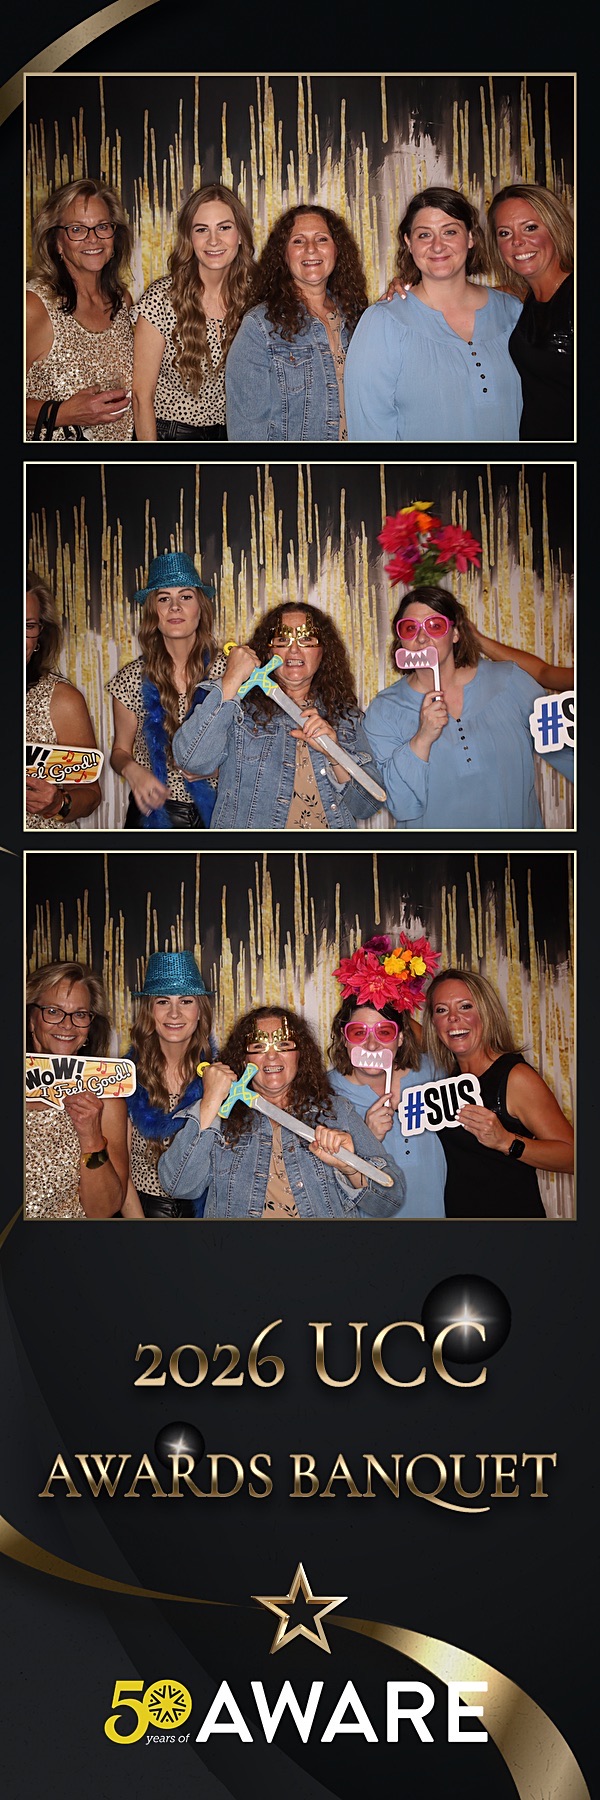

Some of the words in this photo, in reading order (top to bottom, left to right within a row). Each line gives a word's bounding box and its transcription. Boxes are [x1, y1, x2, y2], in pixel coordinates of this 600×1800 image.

[537, 697, 574, 747] #S
[49, 752, 99, 782] Good!
[41, 1086, 50, 1098] I
[54, 1079, 86, 1098] Feel
[87, 1061, 131, 1097] Good!
[404, 1079, 477, 1131] #SUS
